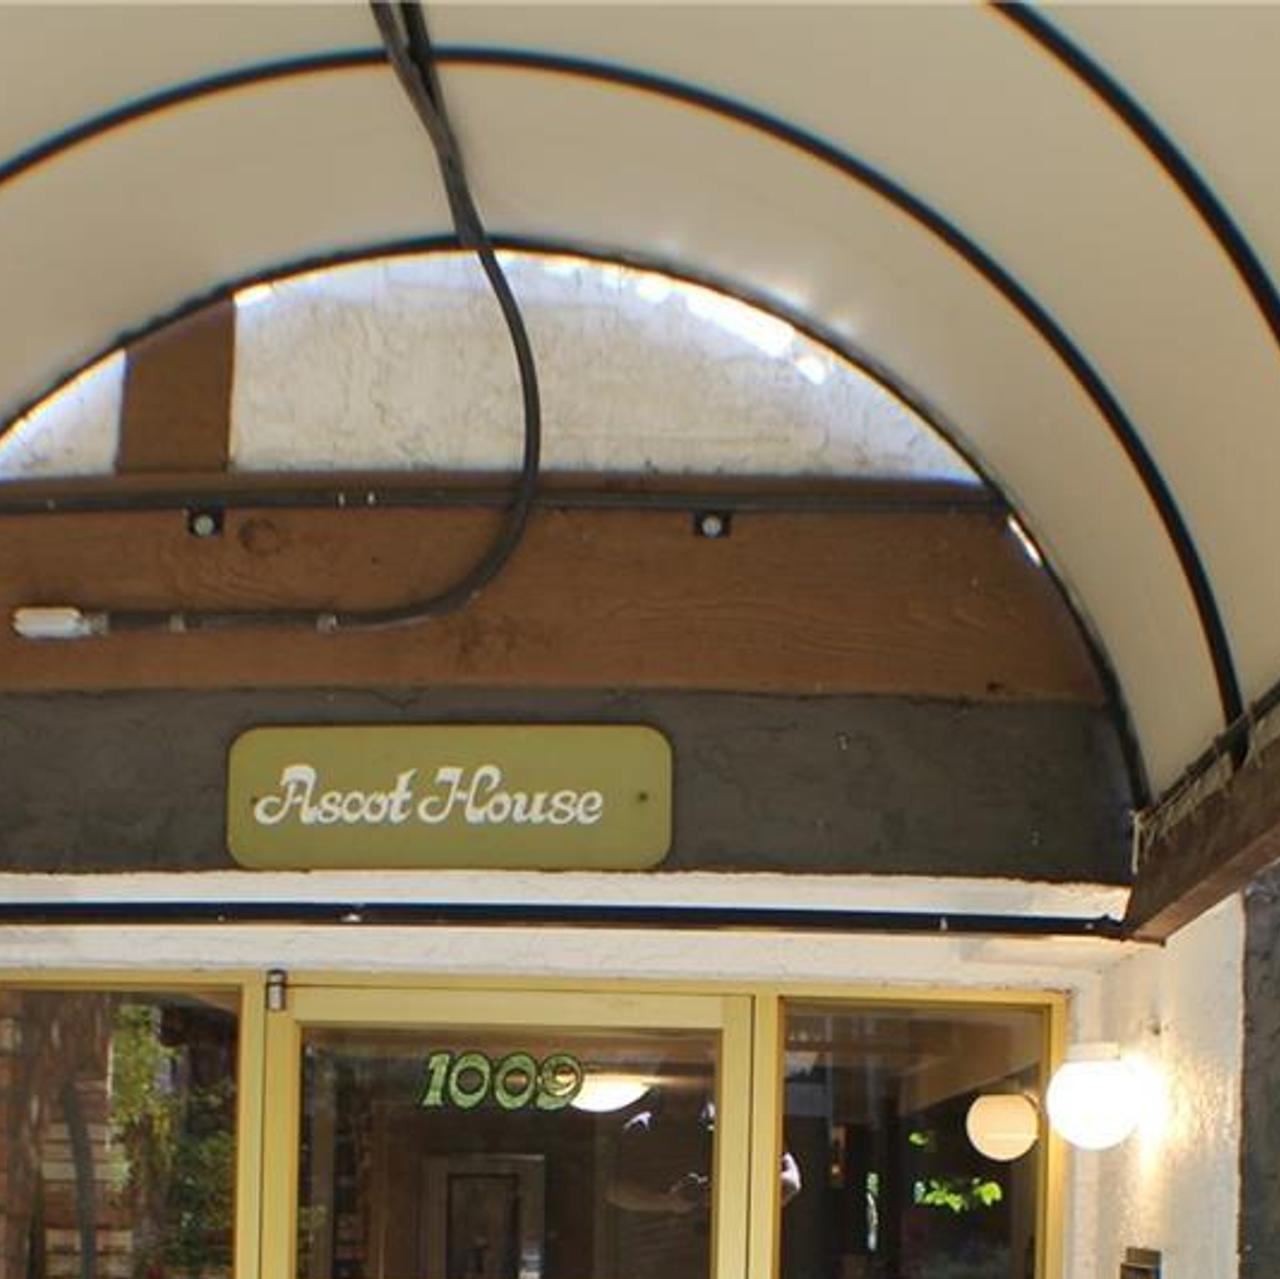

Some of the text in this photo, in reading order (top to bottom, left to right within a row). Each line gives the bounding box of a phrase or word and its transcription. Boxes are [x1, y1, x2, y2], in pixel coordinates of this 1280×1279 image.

[254, 763, 603, 826] Ascot House
[419, 1050, 583, 1111] 1009
